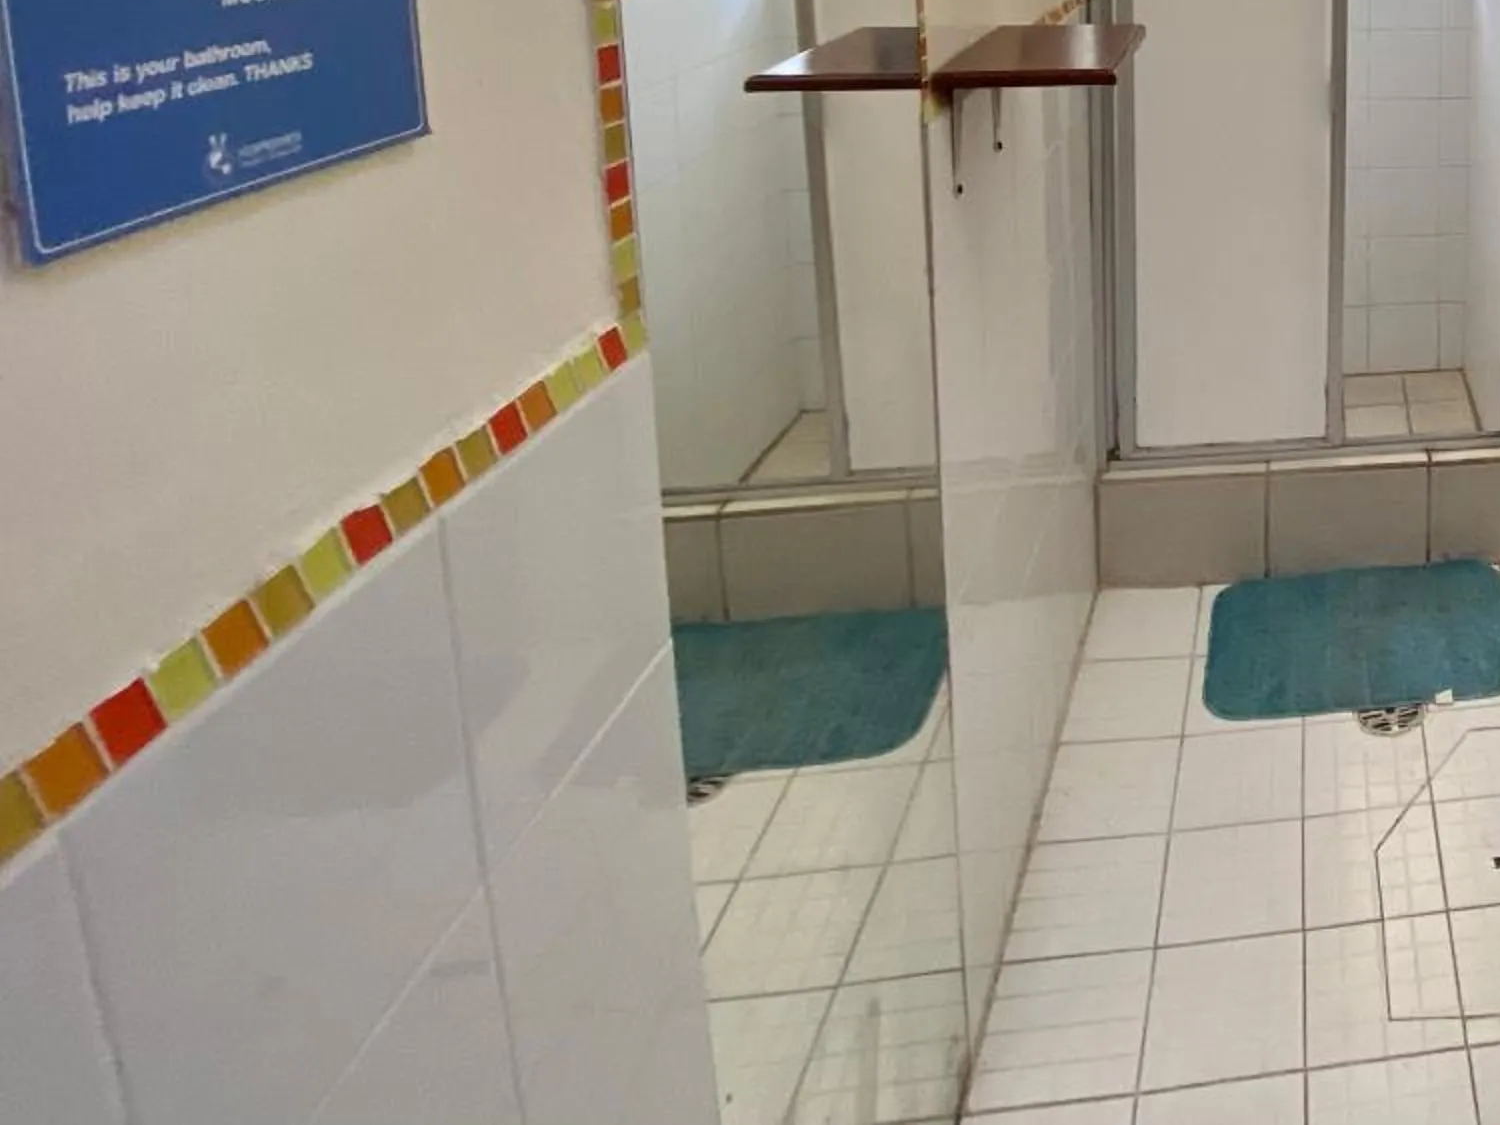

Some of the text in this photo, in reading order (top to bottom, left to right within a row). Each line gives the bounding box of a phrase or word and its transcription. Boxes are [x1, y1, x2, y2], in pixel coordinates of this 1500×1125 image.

[64, 69, 108, 93] This
[113, 64, 131, 84] is
[135, 56, 180, 84] your
[67, 99, 113, 124] help
[118, 88, 166, 112] keep
[170, 81, 183, 100] it
[244, 52, 315, 82] THANKS
